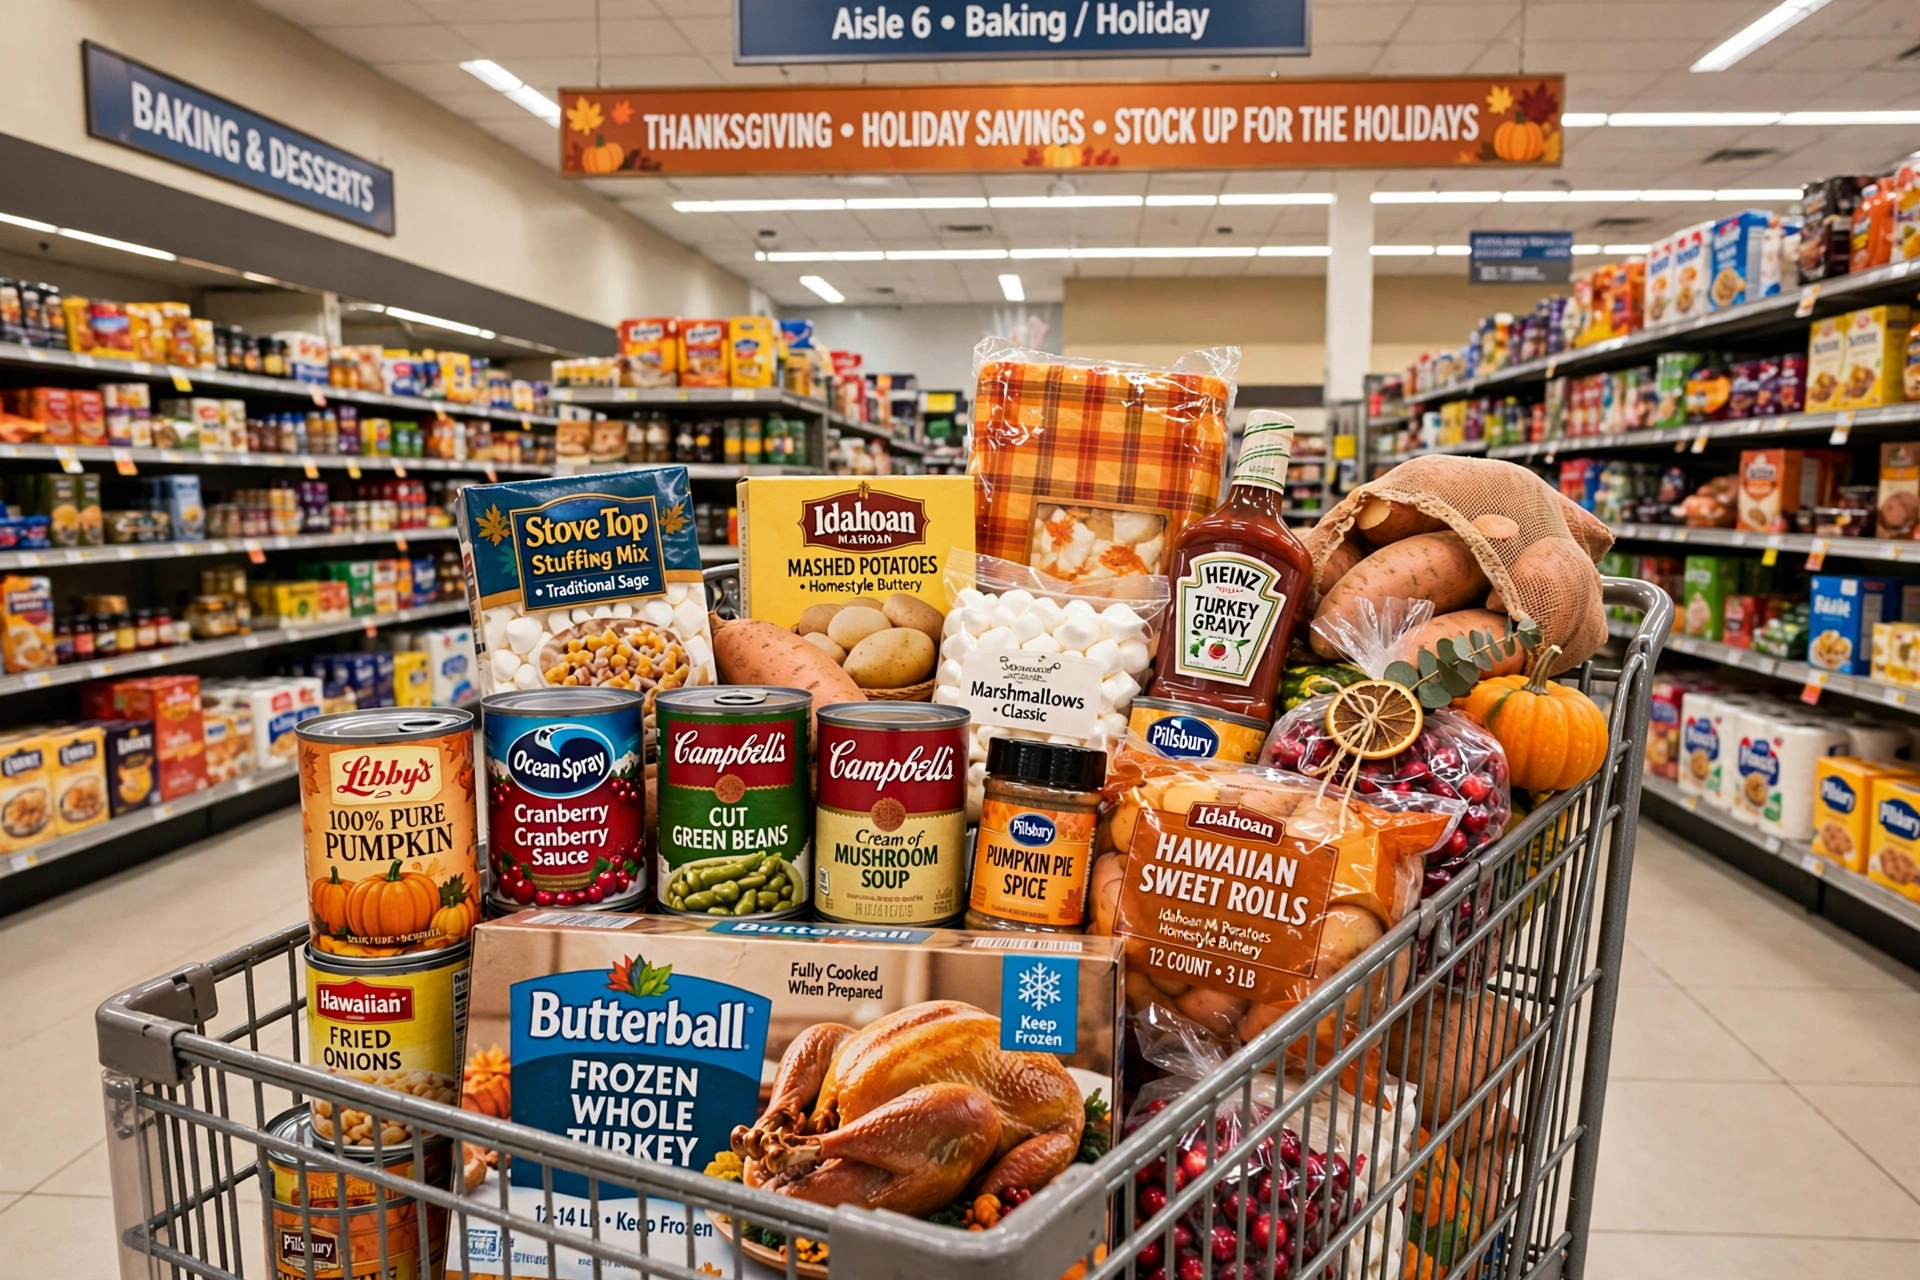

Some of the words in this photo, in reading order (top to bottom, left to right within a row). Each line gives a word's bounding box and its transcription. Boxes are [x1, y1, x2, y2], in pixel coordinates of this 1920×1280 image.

[832, 6, 904, 40] Aisle
[911, 5, 932, 39] 6
[966, 3, 1067, 43] Baking
[1096, 0, 1210, 40] Holiday
[643, 111, 832, 150] THANKSGIVING
[862, 110, 970, 148] HOLIDAY
[975, 108, 1085, 146] SAVINGS
[1114, 107, 1197, 145] STOCK
[1202, 106, 1239, 144] UP
[1243, 105, 1294, 143] FOR
[1298, 105, 1348, 142] THE
[1353, 103, 1480, 142] HOLIDAYS
[131, 80, 240, 164] BAKING
[245, 128, 265, 172] &
[269, 136, 374, 212] DESSERTS
[525, 516, 600, 548] Stove
[600, 506, 649, 541] Top
[813, 501, 917, 537] Idahoan
[531, 548, 613, 576] Stuffing
[615, 543, 650, 565] Mix
[788, 557, 855, 578] MASHED
[859, 555, 938, 576] POTATOES
[546, 576, 616, 598] Traditional
[617, 574, 650, 591] Sage
[809, 578, 874, 595] Homestyle
[877, 578, 922, 593] Buttery
[1205, 565, 1262, 592] HEINZ
[1195, 595, 1260, 620] TURKEY
[1193, 613, 1251, 638] GRAVY
[970, 681, 1085, 710] Marshmallows
[1001, 704, 1047, 722] Classic
[674, 730, 785, 773] Campbell's
[1152, 725, 1212, 757] Pillsbury
[336, 755, 434, 797] Libby's
[513, 750, 560, 779] Ocean
[562, 752, 605, 783] Spray
[830, 740, 954, 791] Campbell's
[329, 810, 384, 832] 100%
[390, 803, 446, 830] PURE
[514, 803, 609, 825] Cranberry
[709, 807, 748, 827] CUT
[1195, 807, 1274, 838] Idahoan
[325, 823, 453, 862] PUMPKIN
[514, 826, 609, 848] Cranberry
[672, 825, 727, 850] GREEN
[732, 824, 788, 850] BEANS
[855, 829, 904, 846] Cream
[907, 830, 926, 847] of
[532, 848, 589, 866] Sauce
[834, 843, 939, 867] MUSHROOM
[985, 844, 1051, 875] PUMPKIN
[1052, 855, 1075, 877] PIE
[1155, 833, 1298, 888] HAWAIIAN
[861, 869, 910, 889] SOUP
[1002, 873, 1048, 900] SPICE
[1139, 863, 1225, 906] SWEET
[1226, 881, 1309, 926] ROLLS
[731, 922, 912, 940] Butterball
[791, 962, 824, 982] Fully
[826, 963, 878, 981] Cooked
[1149, 947, 1165, 967] 12
[1167, 951, 1212, 978] COUNT
[1225, 965, 1235, 984] 3
[1238, 969, 1256, 989] LB
[320, 989, 401, 1014] Hawaiian
[788, 980, 824, 996] When
[827, 982, 883, 1001] Prepared
[530, 991, 745, 1050] Butterball
[1021, 1014, 1057, 1033] Keep
[330, 1026, 391, 1049] FRIED
[1015, 1030, 1062, 1047] Frozen
[323, 1046, 402, 1071] ONIONS
[570, 1059, 699, 1097] FROZEN
[571, 1094, 695, 1132] WHOLE
[566, 1128, 699, 1167] TURKEY
[580, 1208, 597, 1228] L
[660, 1216, 713, 1237] Froen
[283, 1234, 332, 1258] Pillsury
